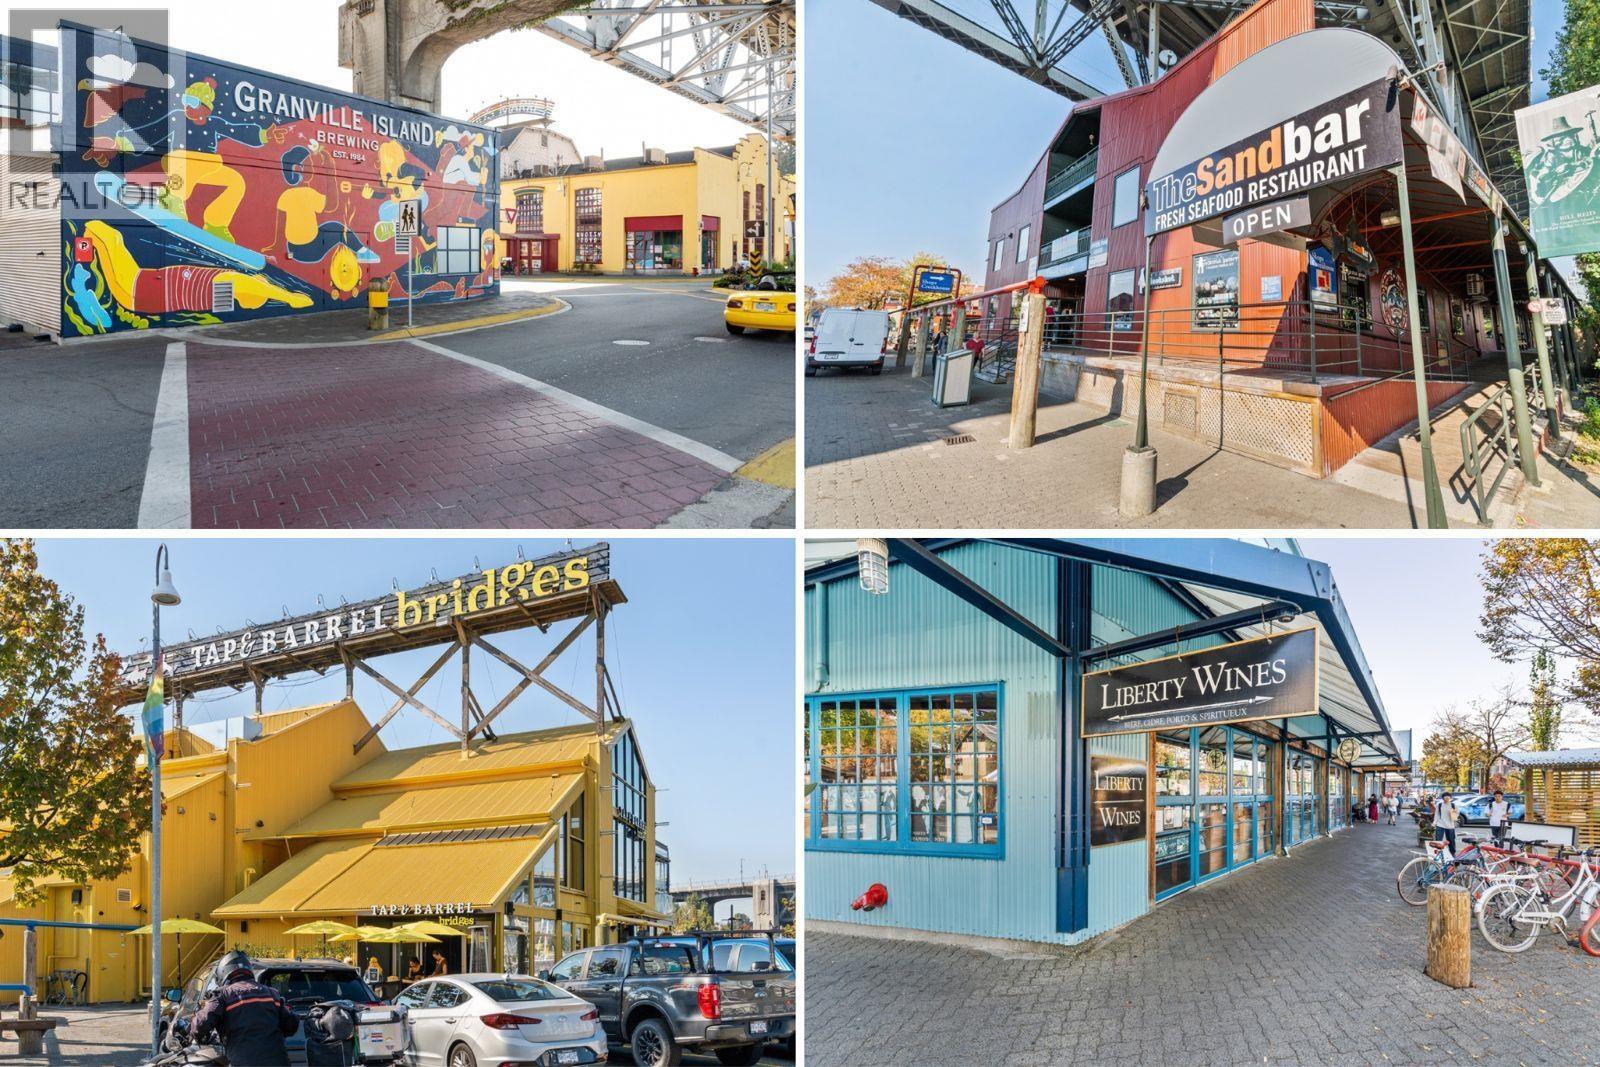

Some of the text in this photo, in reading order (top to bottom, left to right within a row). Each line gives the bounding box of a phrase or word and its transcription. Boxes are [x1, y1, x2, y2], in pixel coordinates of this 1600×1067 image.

[234, 81, 434, 147] GRANVILLE ISLAND
[317, 130, 379, 151] BREWING
[332, 150, 366, 162] EST. 1984
[1155, 145, 1367, 232] FRESH SEAFOOD RESTAURANT
[1233, 203, 1292, 237] OPEN
[396, 557, 591, 628] bridges
[190, 638, 237, 669] TAP
[262, 605, 387, 654] BARREL
[1101, 659, 1287, 710] LIBERTY WINES
[1199, 708, 1248, 721] SPIRITUEUX
[1094, 770, 1144, 792] LIBERTY
[1099, 807, 1141, 828] WINES
[370, 904, 398, 916] TAP
[414, 902, 474, 915] BARREL
[439, 916, 474, 926] bridges
